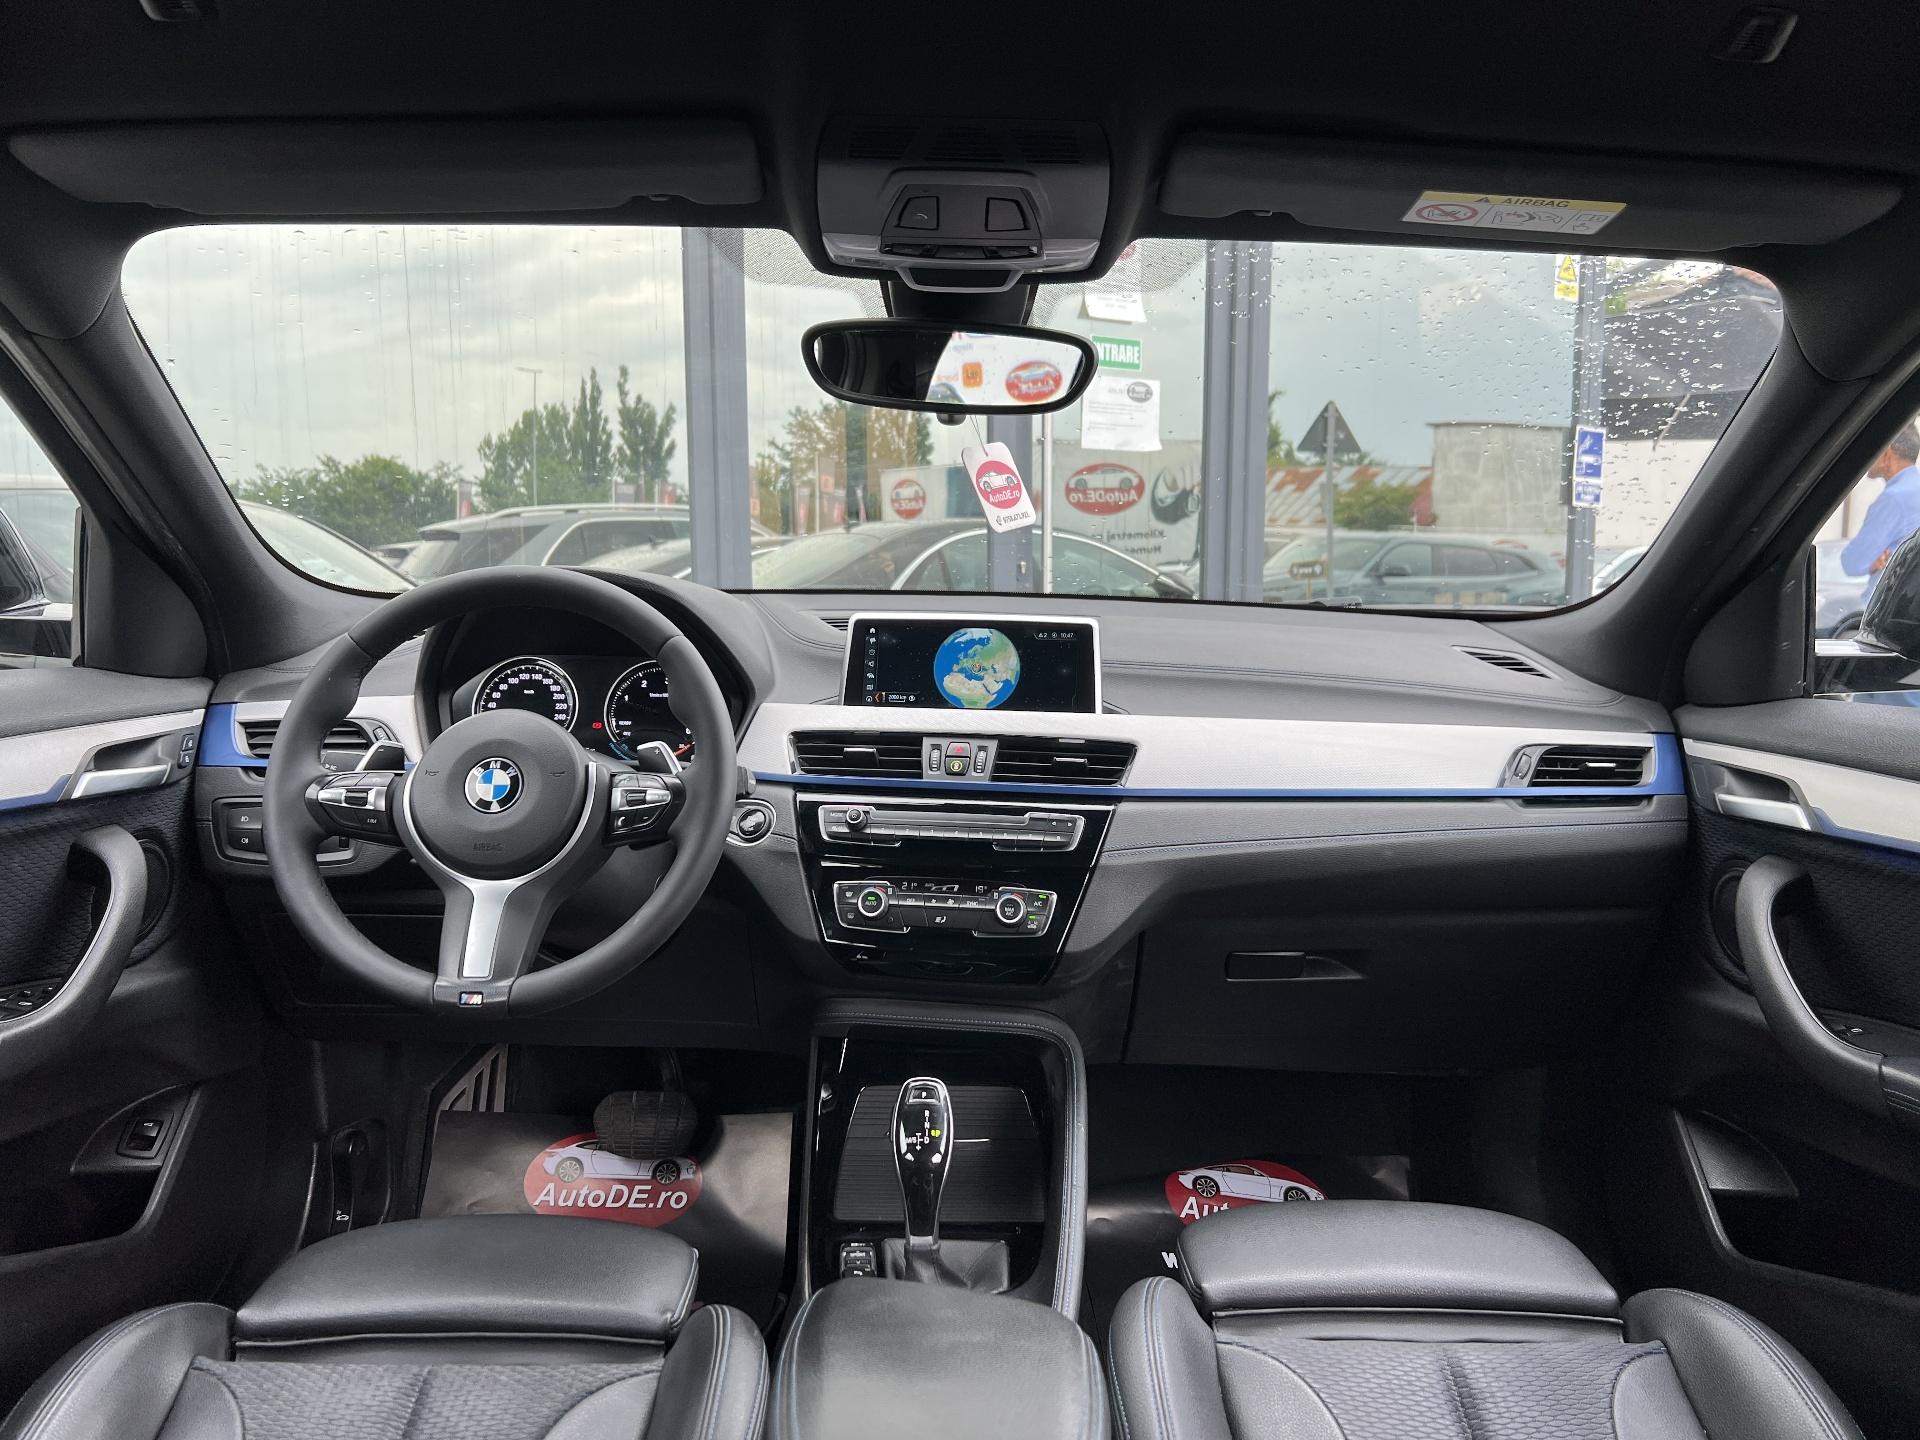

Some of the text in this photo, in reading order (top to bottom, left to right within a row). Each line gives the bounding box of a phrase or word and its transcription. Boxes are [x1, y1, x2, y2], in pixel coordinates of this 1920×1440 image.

[1502, 197, 1571, 208] AIRBAG
[1097, 343, 1139, 363] NTRARE
[640, 680, 648, 688] 2
[473, 760, 518, 777] BMW
[532, 1182, 689, 1210] AutoDE.ro
